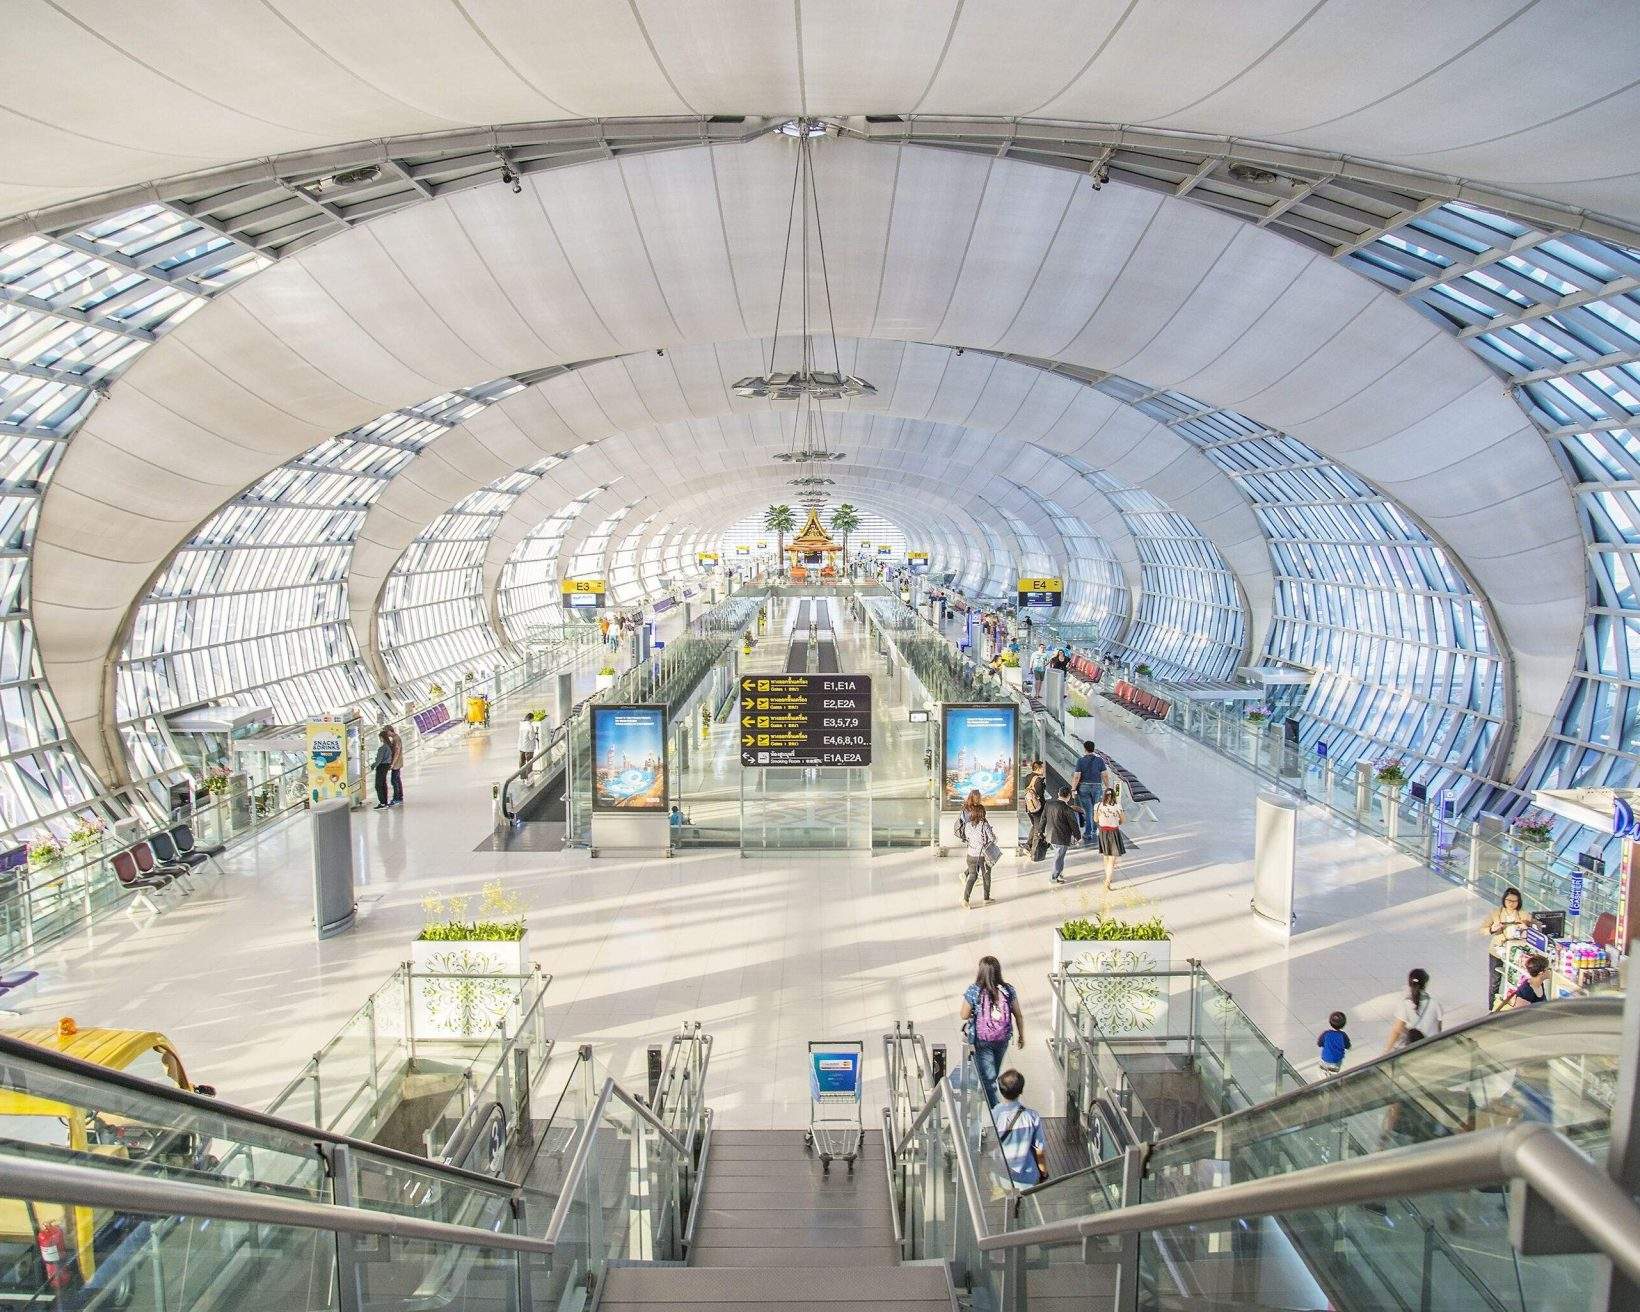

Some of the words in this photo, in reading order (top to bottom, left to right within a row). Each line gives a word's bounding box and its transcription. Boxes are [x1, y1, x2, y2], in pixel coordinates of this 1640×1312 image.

[576, 582, 590, 590] E3
[1034, 580, 1046, 590] E4
[824, 682, 856, 691] E1,E1A
[824, 700, 856, 709] E2,E2A
[824, 718, 858, 727] E3,5,7,9
[824, 754, 862, 763] E1A,E2A
